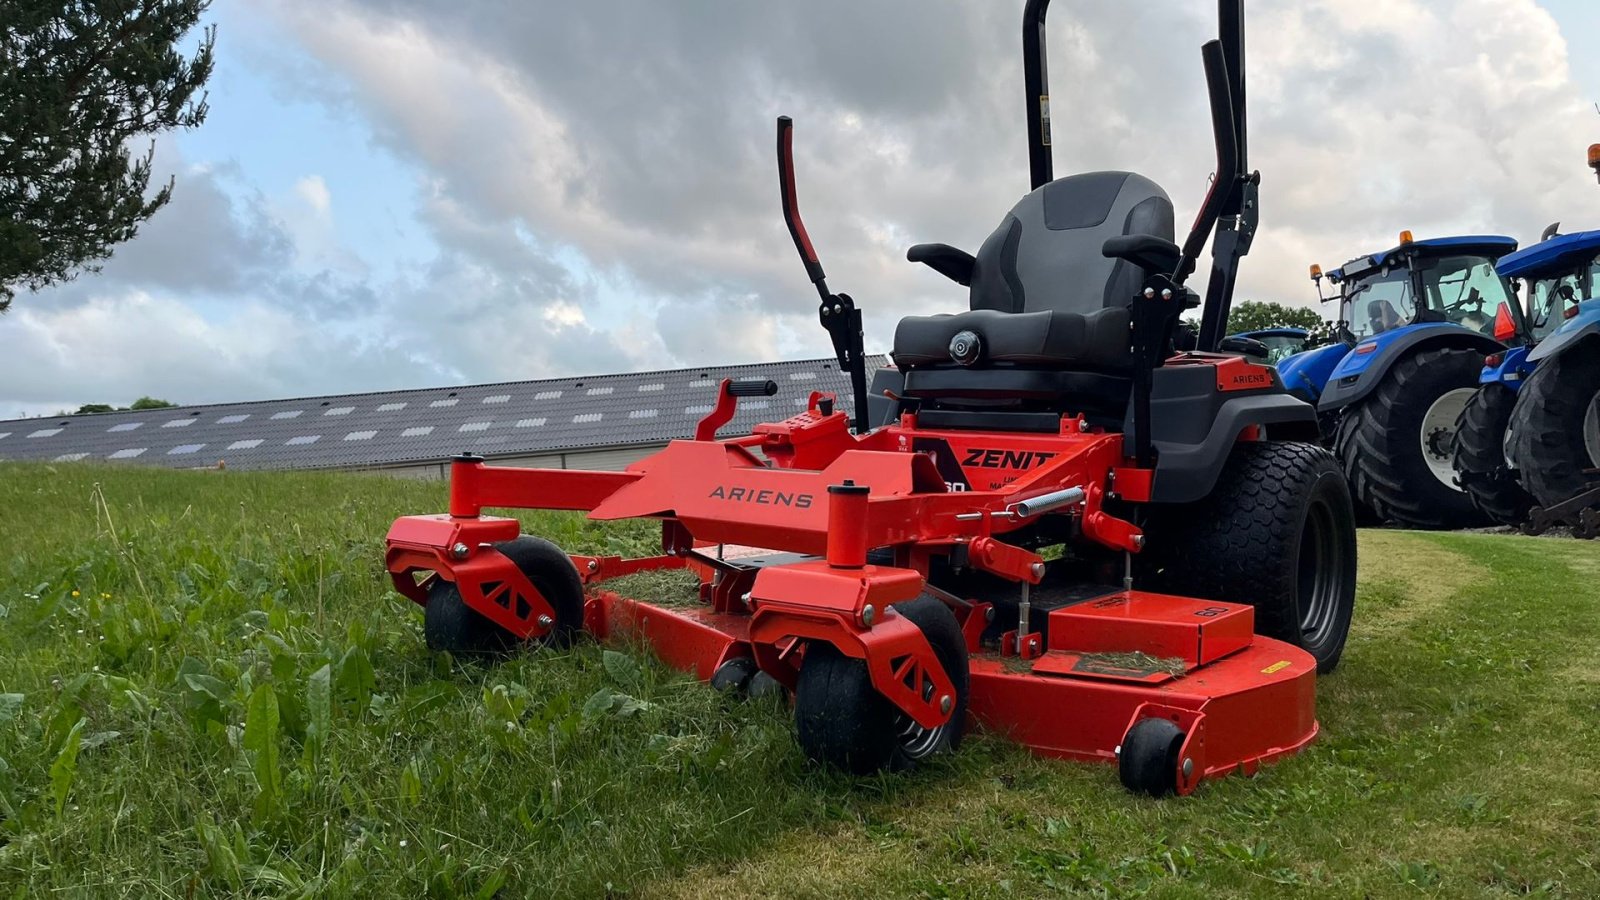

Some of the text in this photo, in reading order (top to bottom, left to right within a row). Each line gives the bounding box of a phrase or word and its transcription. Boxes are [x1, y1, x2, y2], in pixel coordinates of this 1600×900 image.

[1233, 375, 1264, 383] ARIENS
[961, 448, 1060, 470] ZENIT
[708, 486, 813, 508] ARIENS
[1193, 606, 1229, 617] 60
